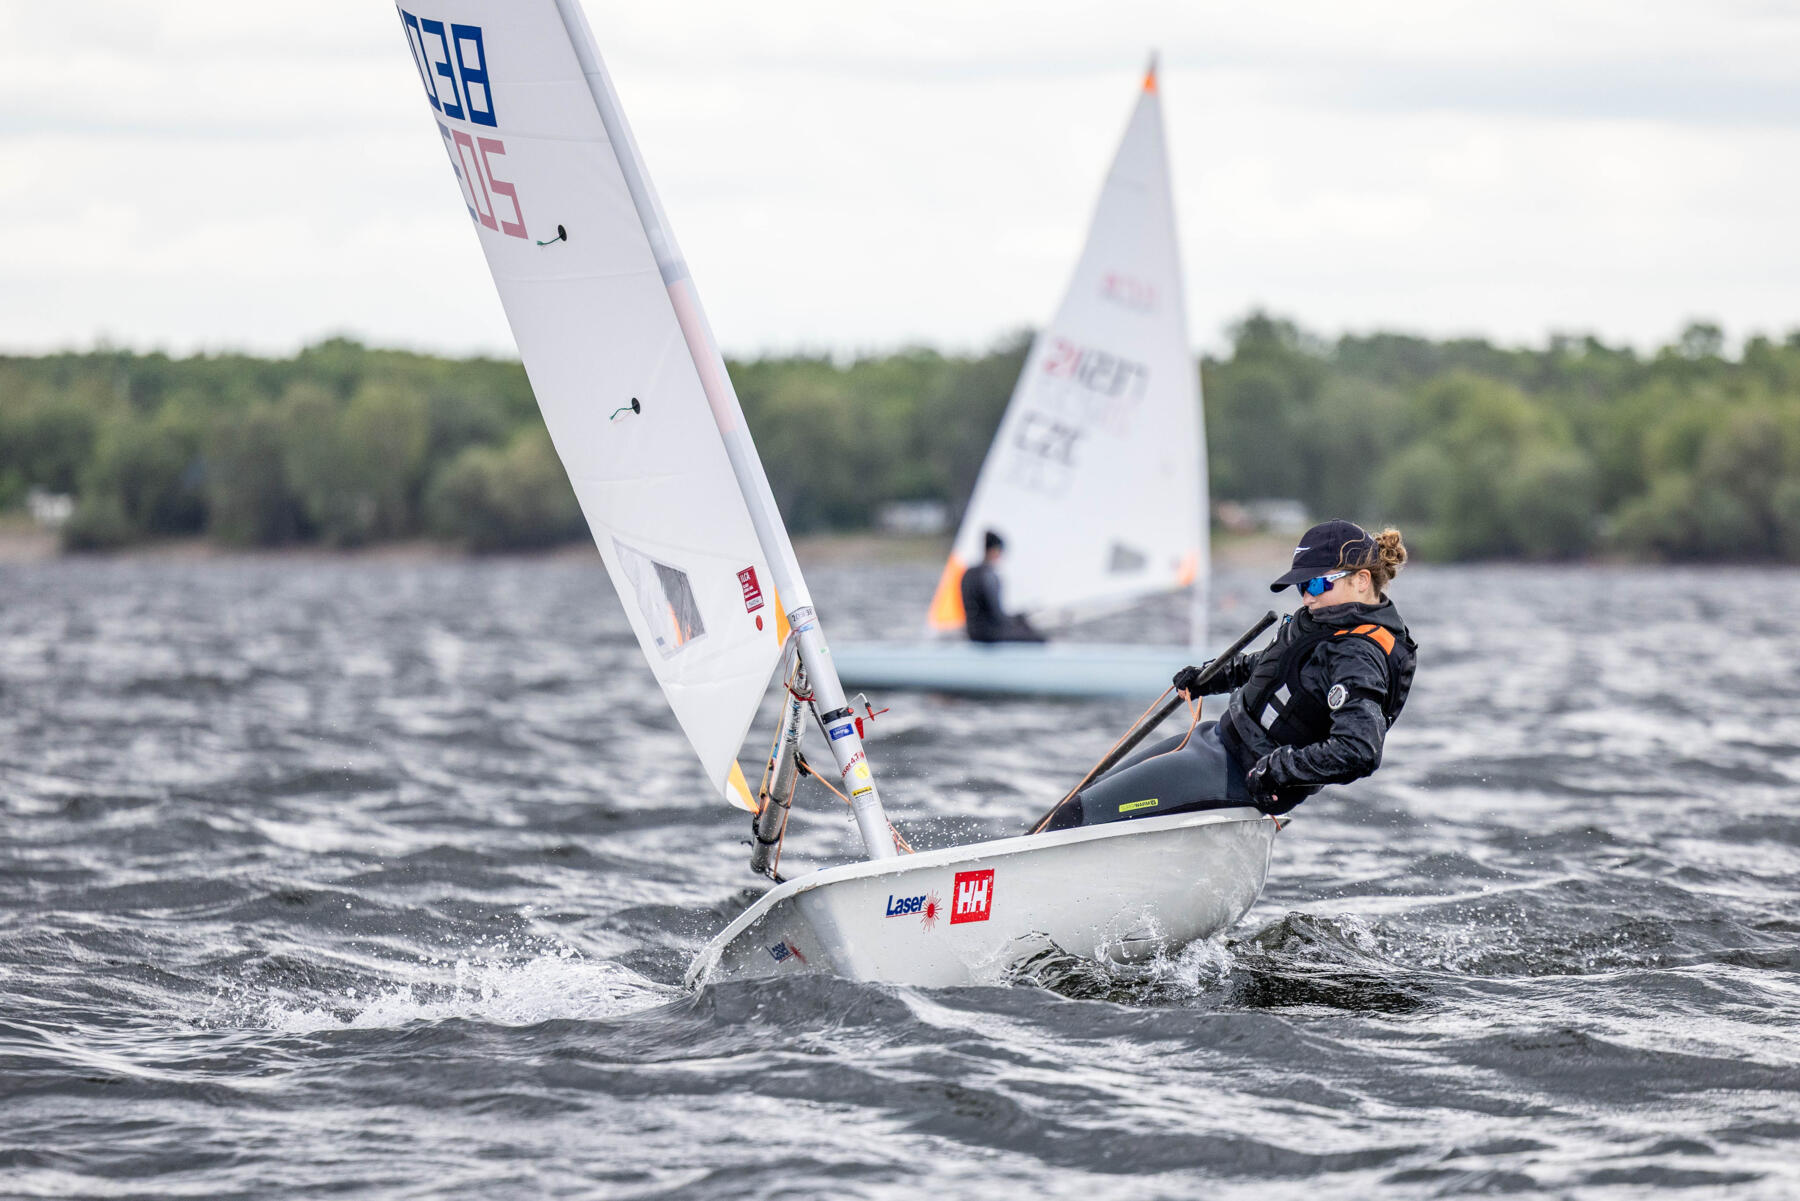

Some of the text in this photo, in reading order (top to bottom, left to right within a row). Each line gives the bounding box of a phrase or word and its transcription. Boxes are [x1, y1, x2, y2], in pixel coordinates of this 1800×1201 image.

[397, 5, 498, 128] 038
[886, 879, 988, 917] Laser HH
